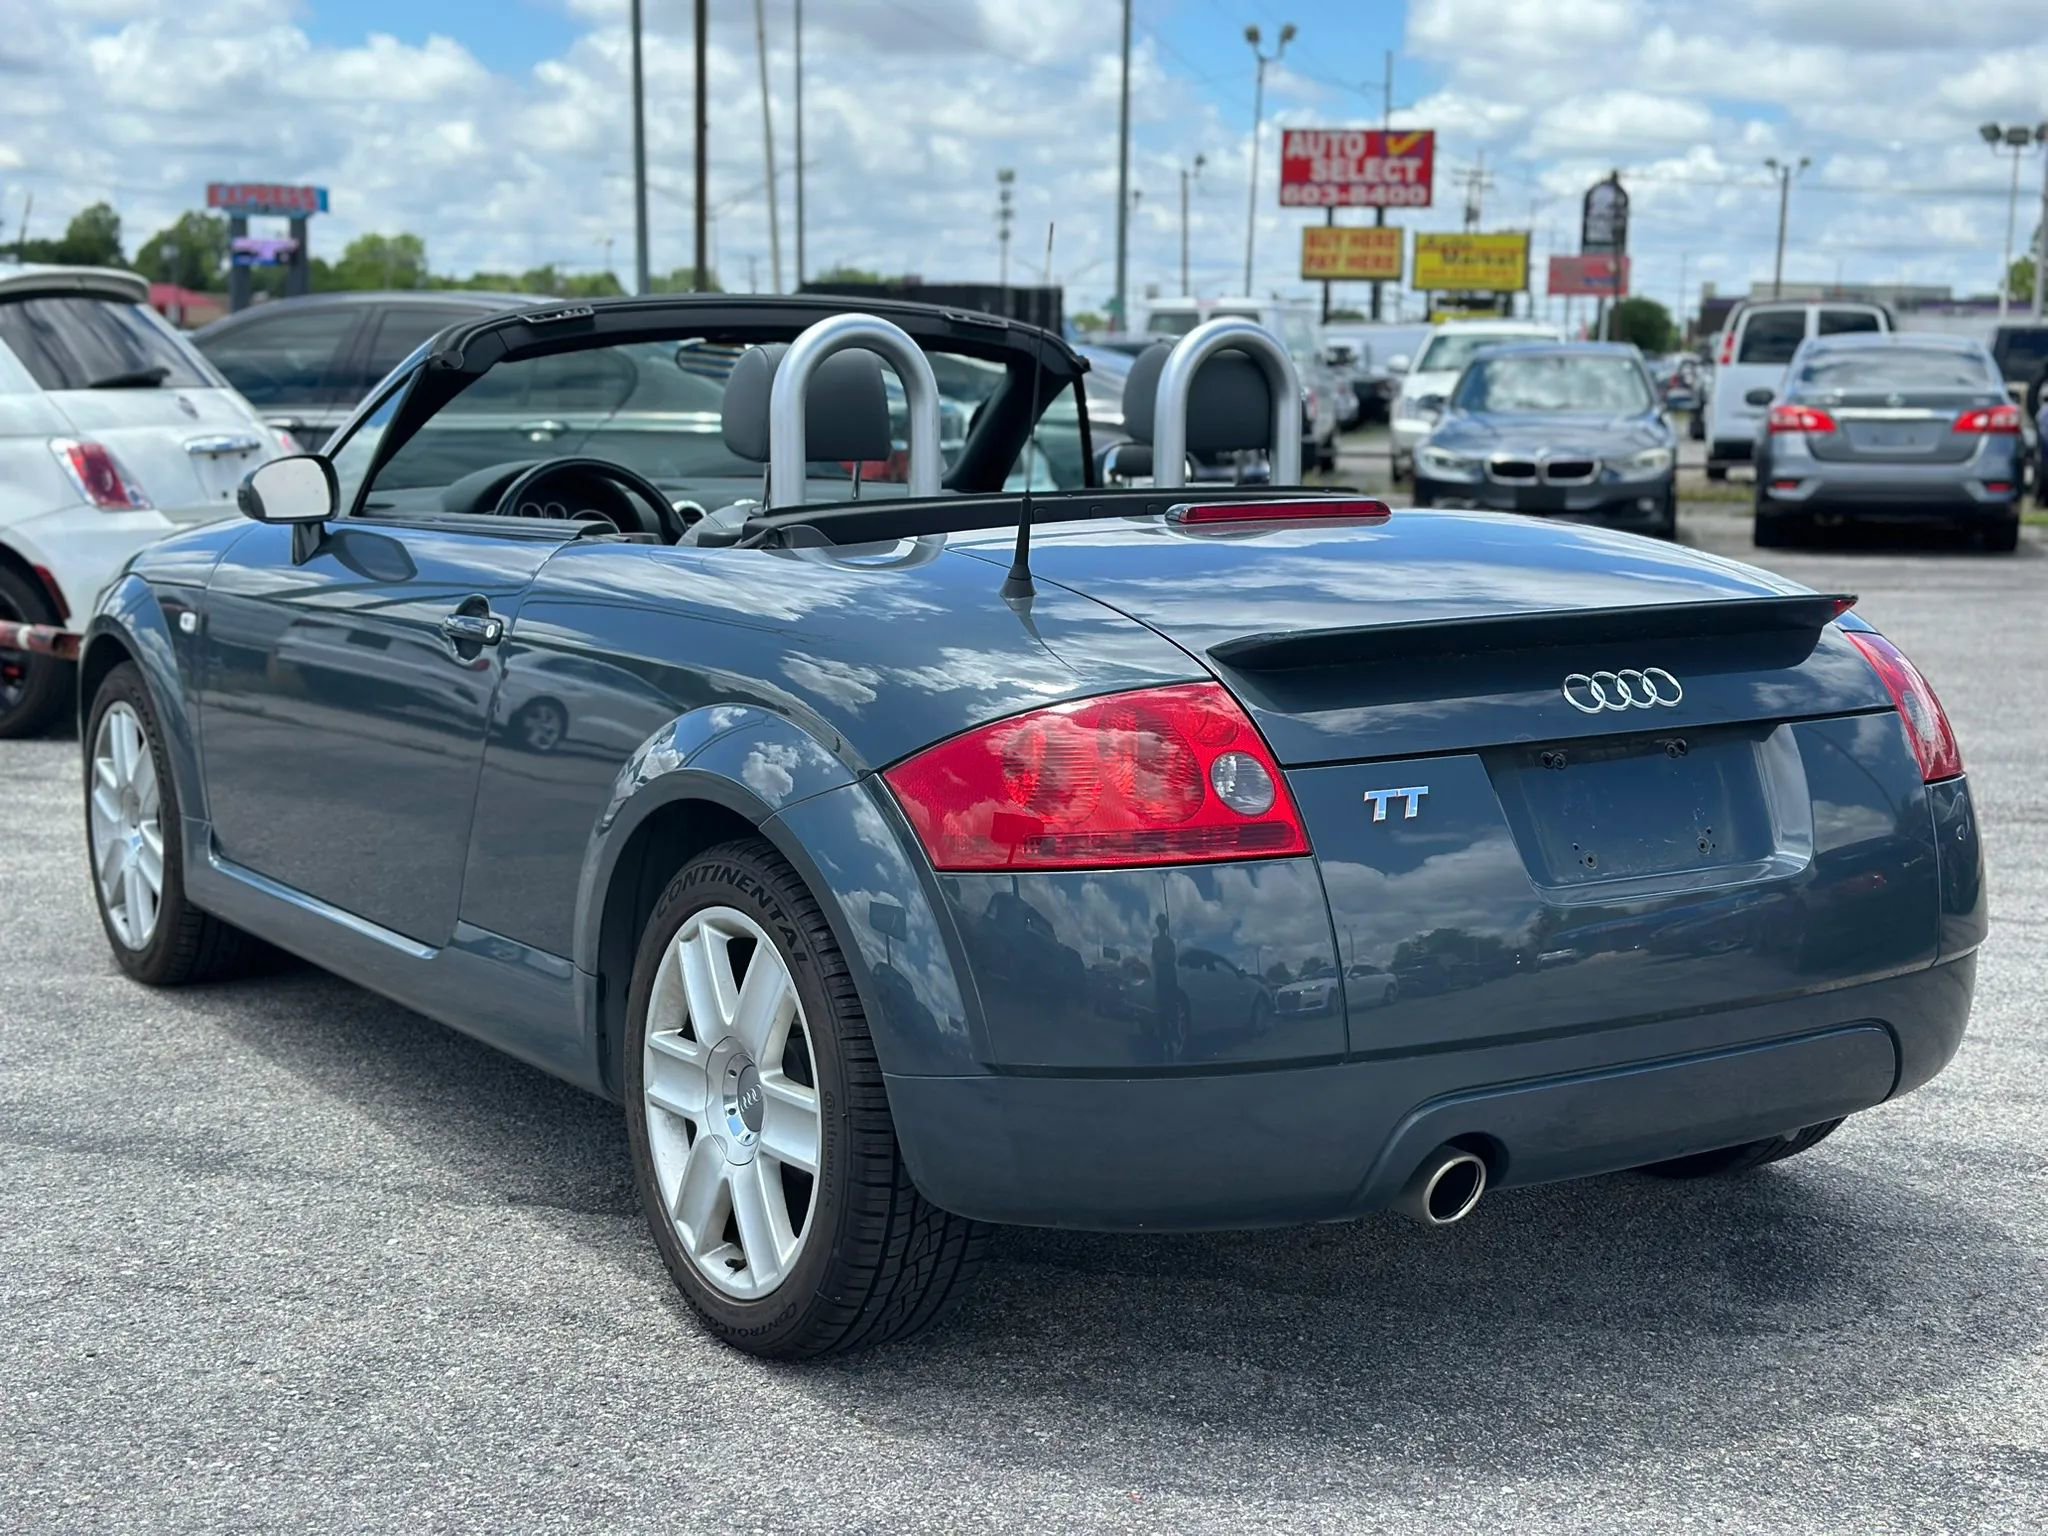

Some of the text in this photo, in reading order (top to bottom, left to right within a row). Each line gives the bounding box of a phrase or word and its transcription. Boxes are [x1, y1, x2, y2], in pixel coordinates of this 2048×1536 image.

[1284, 131, 1366, 160] AUTO
[1309, 157, 1423, 183] SELECT
[208, 184, 316, 212] EXPRESS
[1306, 230, 1396, 249] BUY HERE
[1305, 252, 1394, 270] PAY HERE
[1363, 785, 1429, 823] TT
[657, 865, 808, 975] CONTINENTAL
